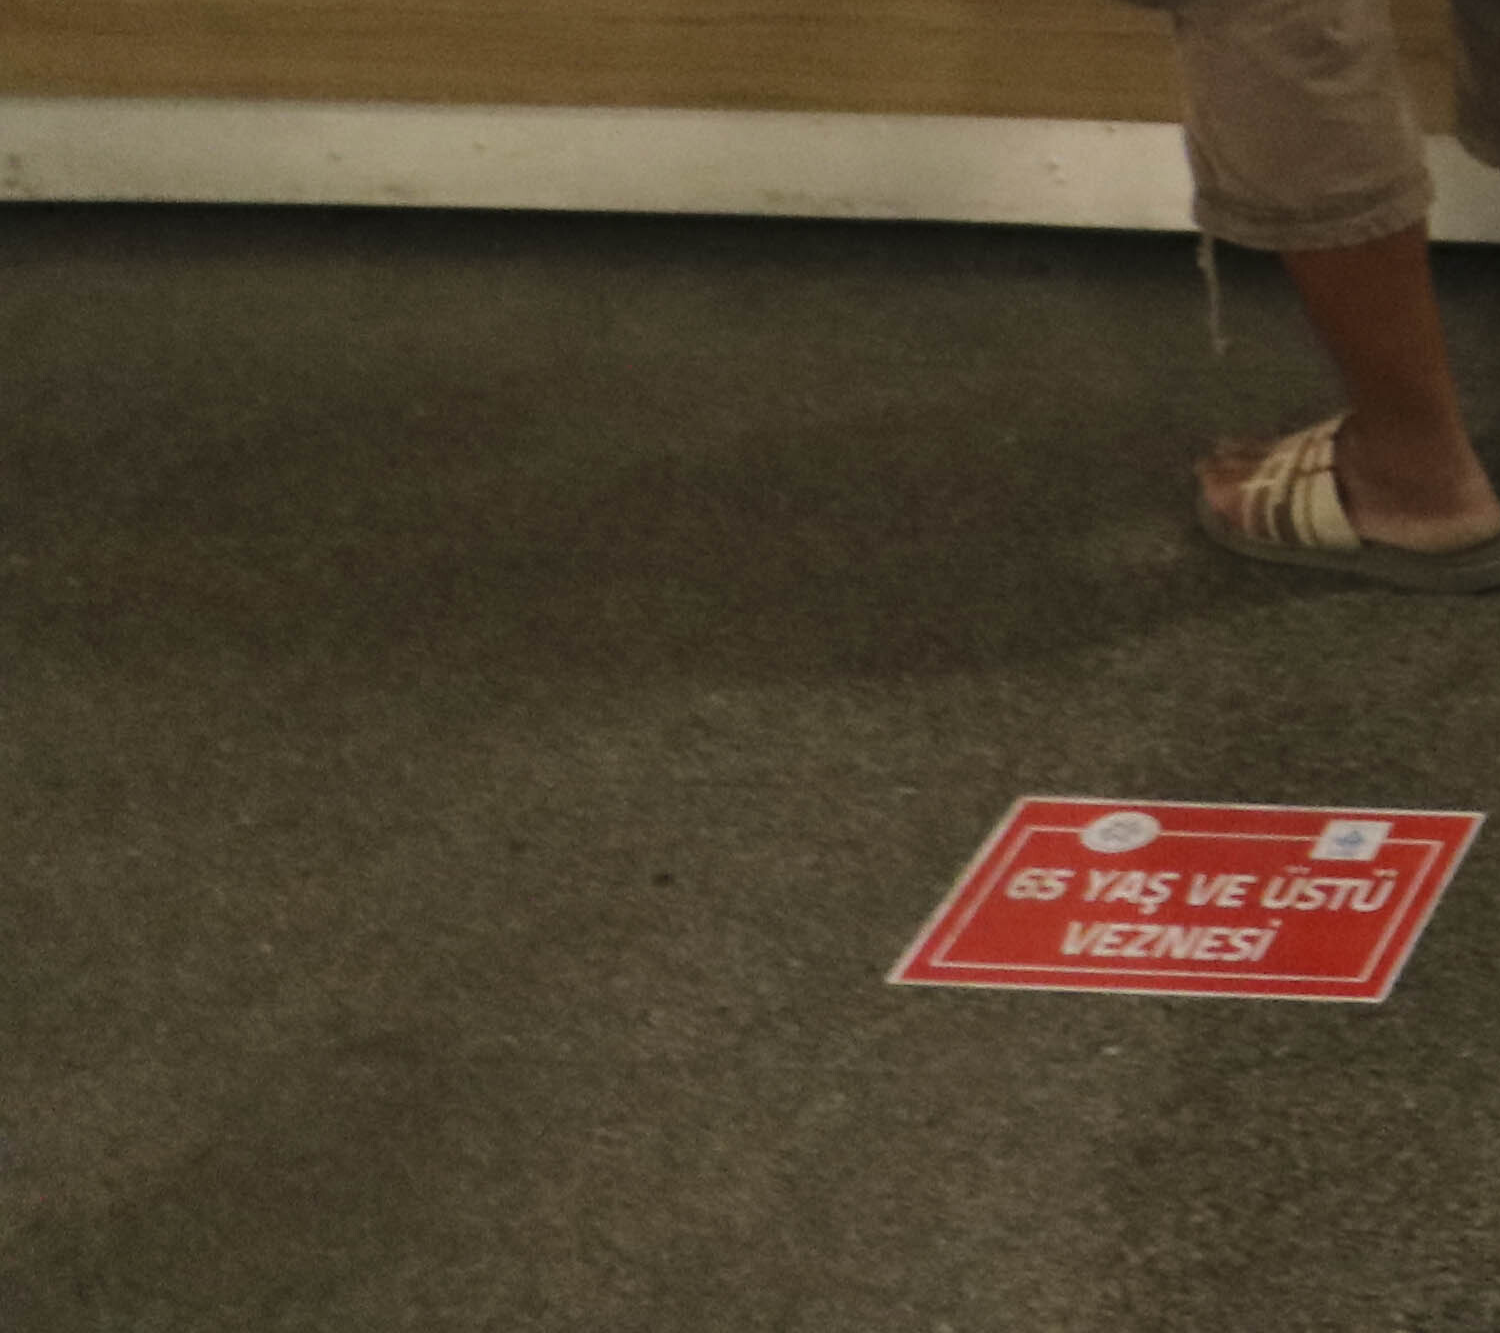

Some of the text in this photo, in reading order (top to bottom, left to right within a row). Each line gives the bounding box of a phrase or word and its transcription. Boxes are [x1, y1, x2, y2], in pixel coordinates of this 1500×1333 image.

[1005, 866, 1400, 913] 65 YAŞ VE ÜSTÜ
[1058, 918, 1283, 963] VEZNESİ
